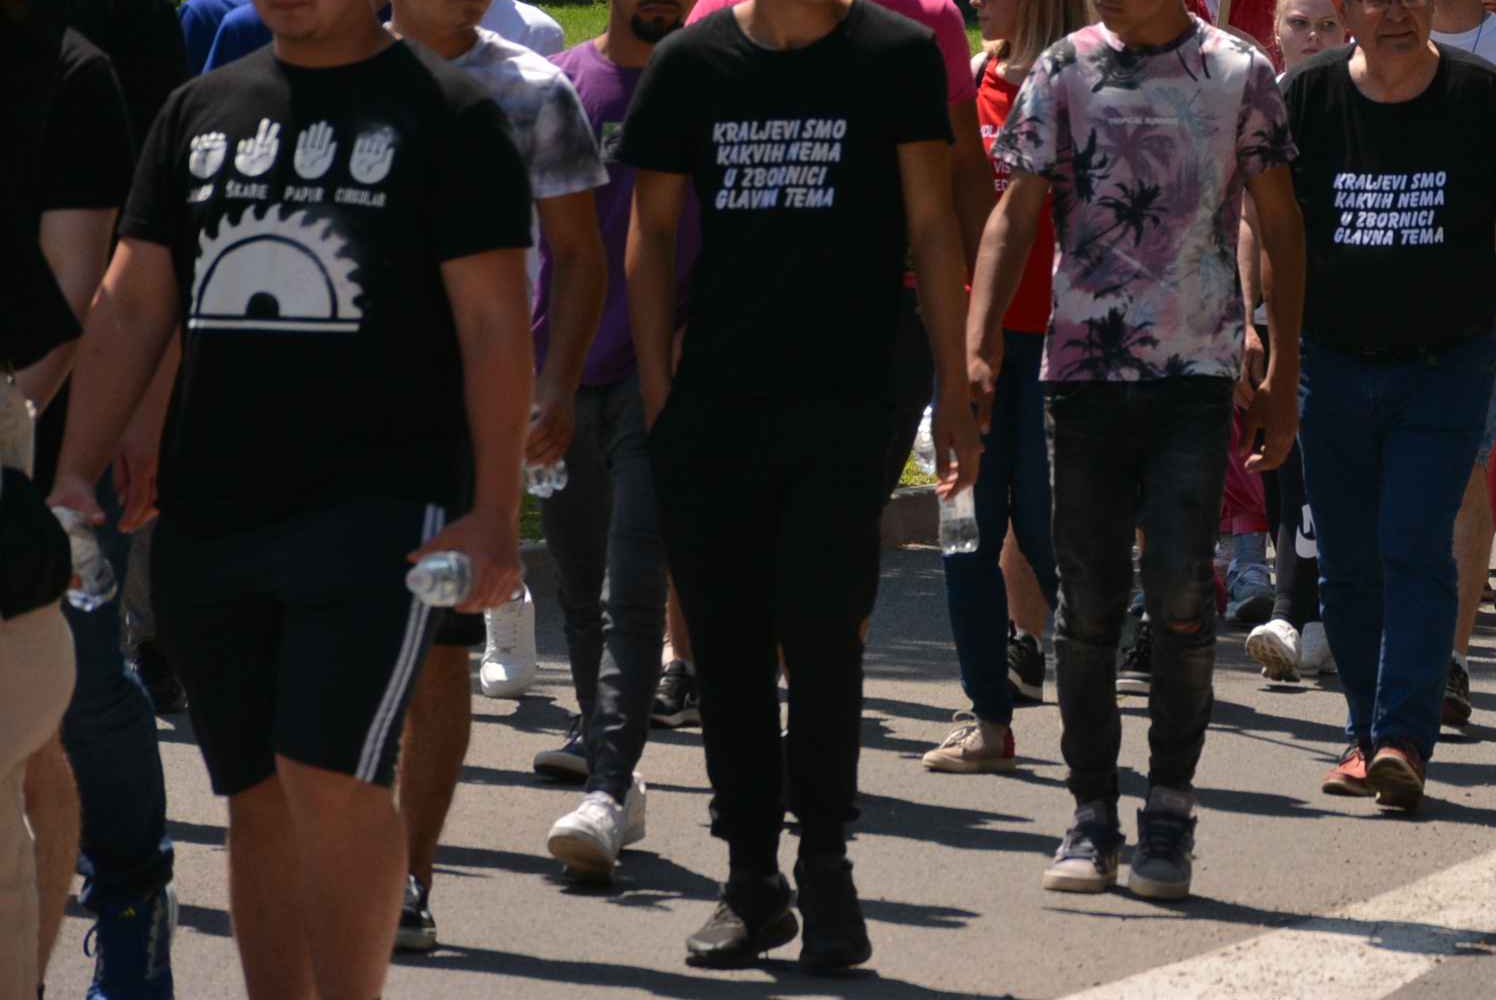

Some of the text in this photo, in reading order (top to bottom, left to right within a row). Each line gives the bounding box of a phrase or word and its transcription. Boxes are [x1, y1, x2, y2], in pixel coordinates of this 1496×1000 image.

[713, 119, 847, 143] KRALJEVI SMO
[717, 143, 785, 165] KAKVIH
[724, 168, 737, 187] U
[1334, 172, 1447, 191] KRALJEVI SMO
[785, 187, 835, 208] TEMA
[1335, 190, 1445, 209] KAKVIH NEMA
[1341, 210, 1435, 228] U ZBORNICI
[1334, 227, 1444, 246] GLAVNA TEMA
